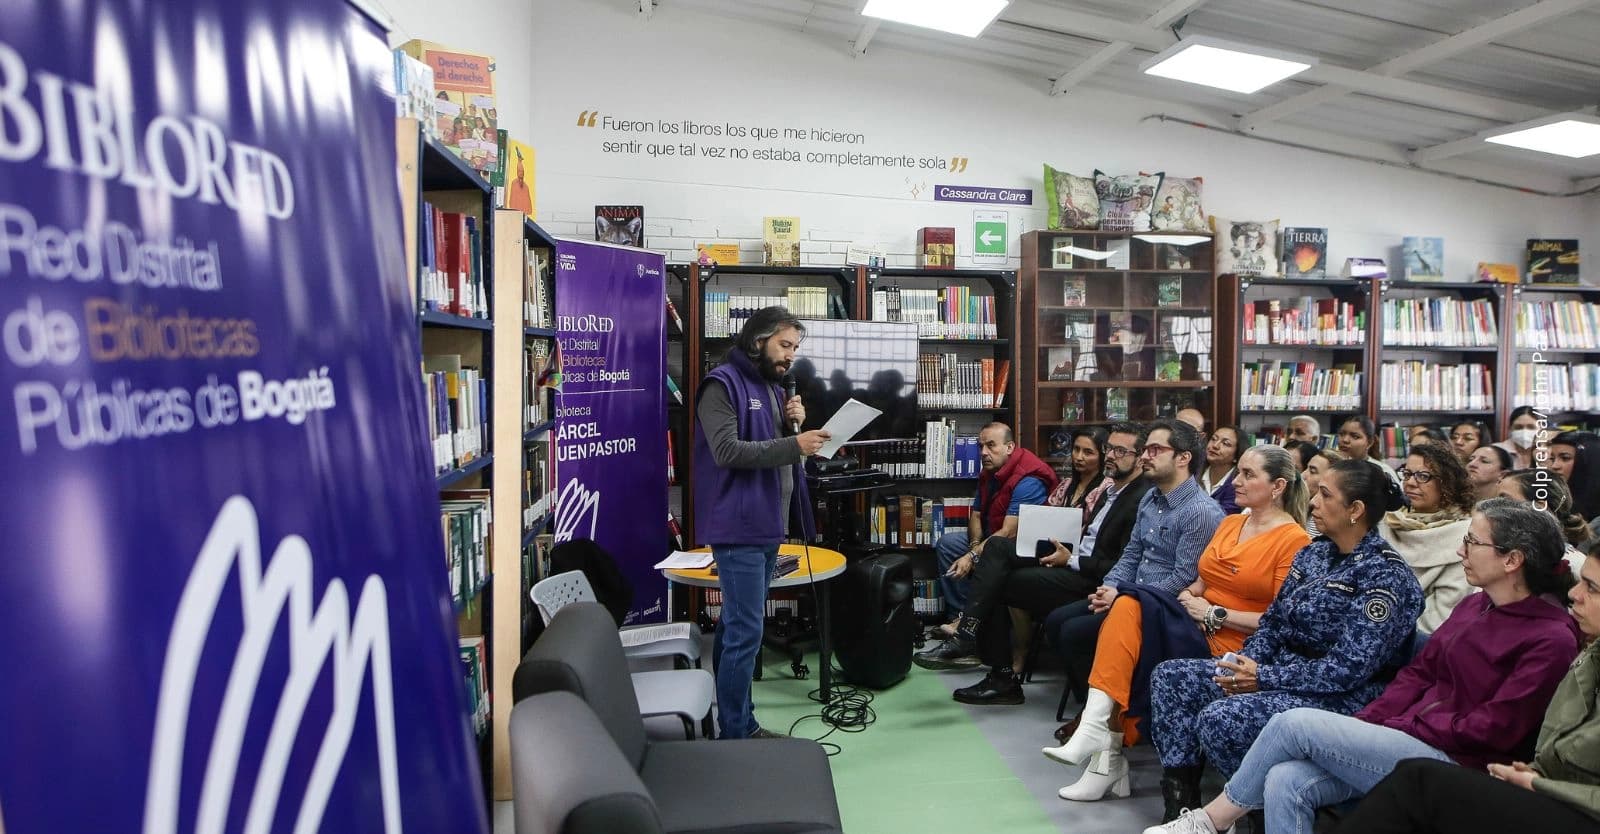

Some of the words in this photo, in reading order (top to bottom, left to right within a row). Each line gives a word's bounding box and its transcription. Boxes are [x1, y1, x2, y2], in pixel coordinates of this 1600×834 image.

[438, 56, 478, 69] Derechos
[436, 69, 445, 79] al
[448, 69, 483, 82] derecho
[602, 116, 654, 133] Fueron
[658, 119, 679, 134] los
[683, 119, 722, 136] libros
[726, 122, 746, 138] los
[750, 126, 778, 141] que
[784, 128, 807, 140] me
[810, 127, 865, 145] hicieron
[602, 140, 643, 154] sentir
[646, 143, 675, 158] que
[678, 142, 696, 157] tal
[700, 146, 726, 159] vez
[730, 147, 749, 160] no
[752, 146, 801, 163] estaba
[806, 150, 915, 168] completamente
[918, 156, 947, 170] sola
[940, 186, 997, 202] Cassandra
[998, 189, 1027, 203] Clare
[598, 207, 641, 218] ANIMAL
[1288, 231, 1326, 243] TIERRA
[1532, 242, 1563, 252] ANIMAL
[560, 262, 576, 271] VIDA
[3, 296, 80, 367] de
[557, 314, 614, 333] IBLORED
[587, 370, 599, 382] de
[599, 368, 630, 384] Bogotá
[195, 374, 239, 427] de
[556, 405, 592, 418] blioteca
[557, 420, 602, 441] ÁRCEL
[558, 443, 587, 462] UEN
[589, 437, 637, 458] PASTOR
